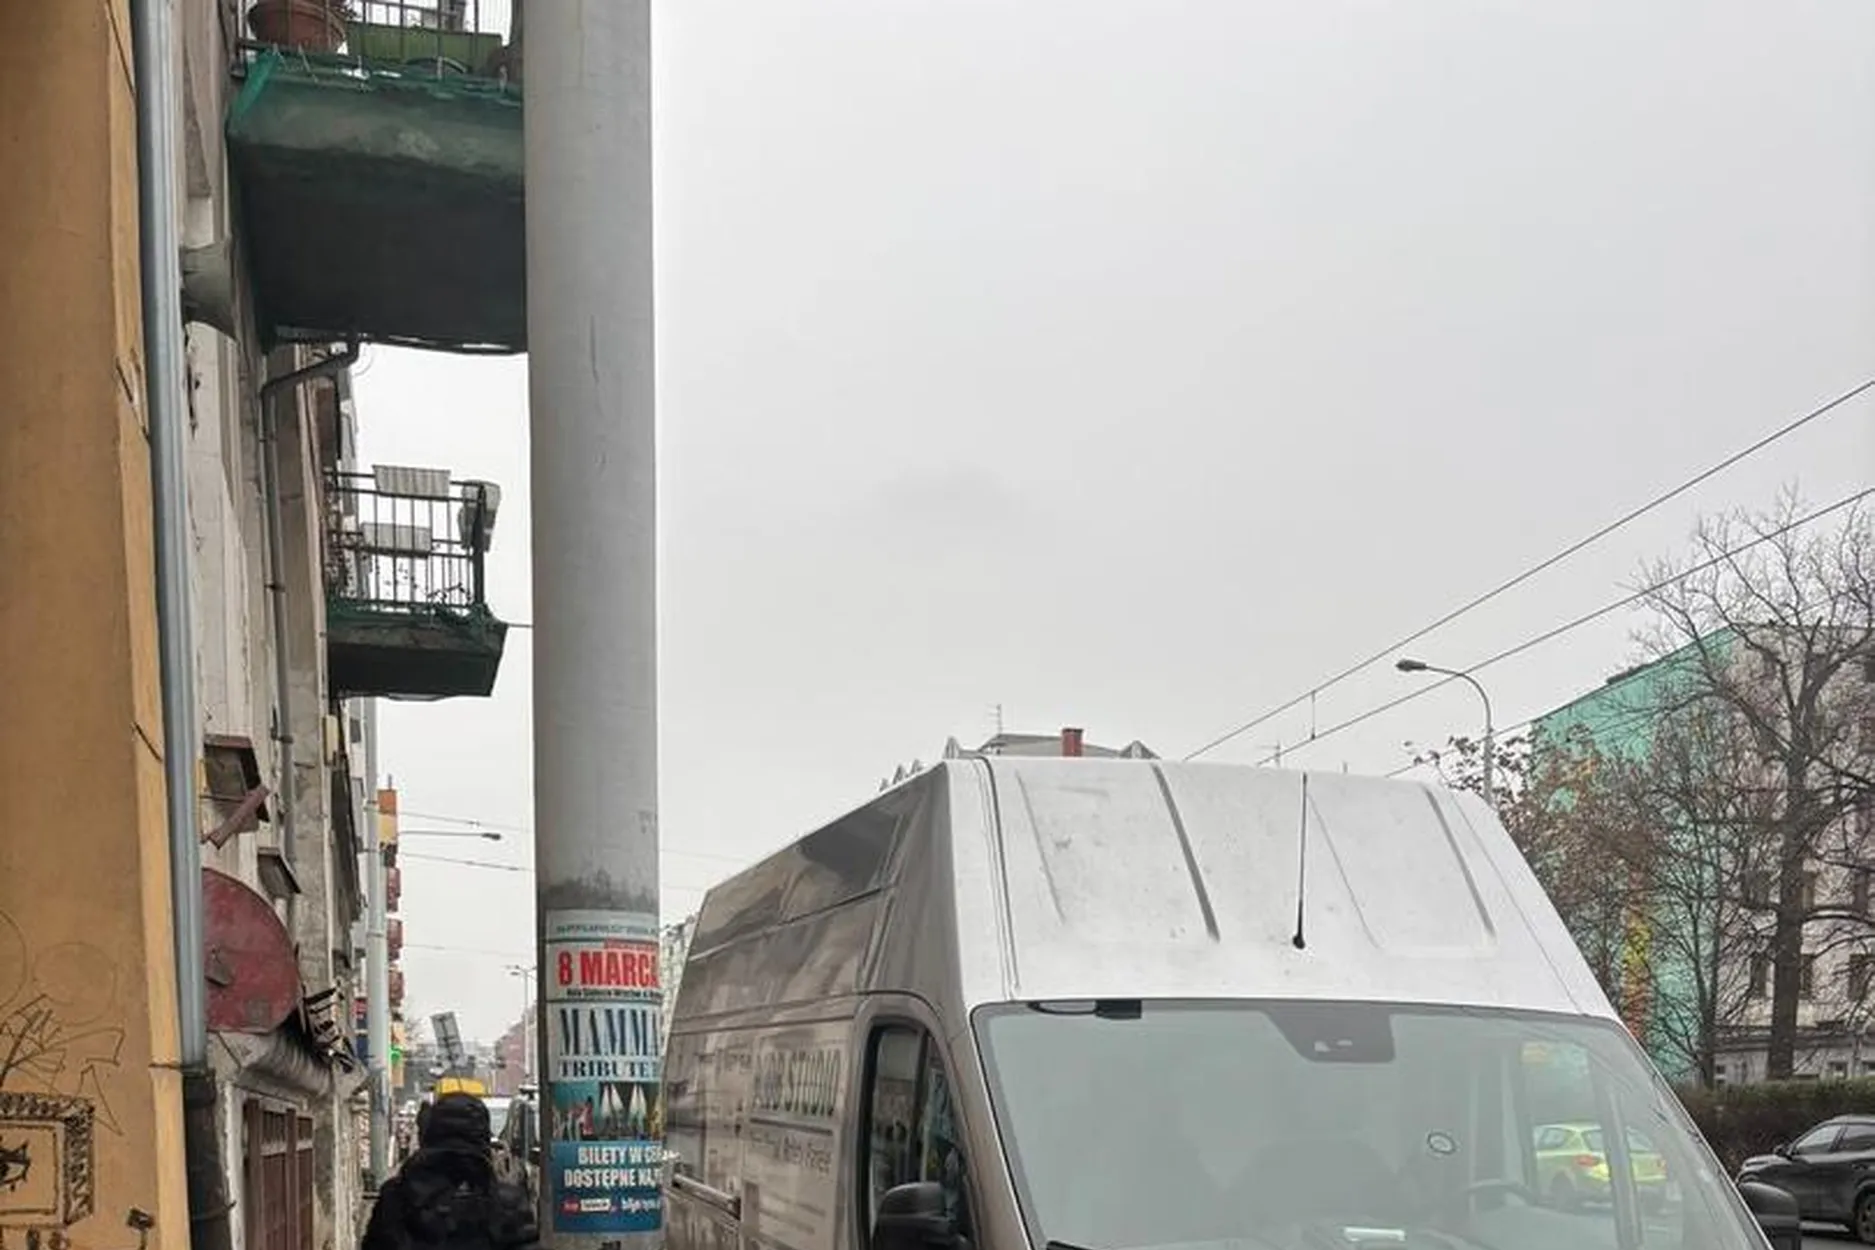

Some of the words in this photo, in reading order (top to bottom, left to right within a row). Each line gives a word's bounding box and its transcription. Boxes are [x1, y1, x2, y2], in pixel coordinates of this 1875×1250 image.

[558, 951, 573, 986] 8
[557, 1061, 650, 1078] TRIBUTE
[577, 1145, 627, 1165] BILETY
[563, 1167, 636, 1190] DOSTĘPNE
